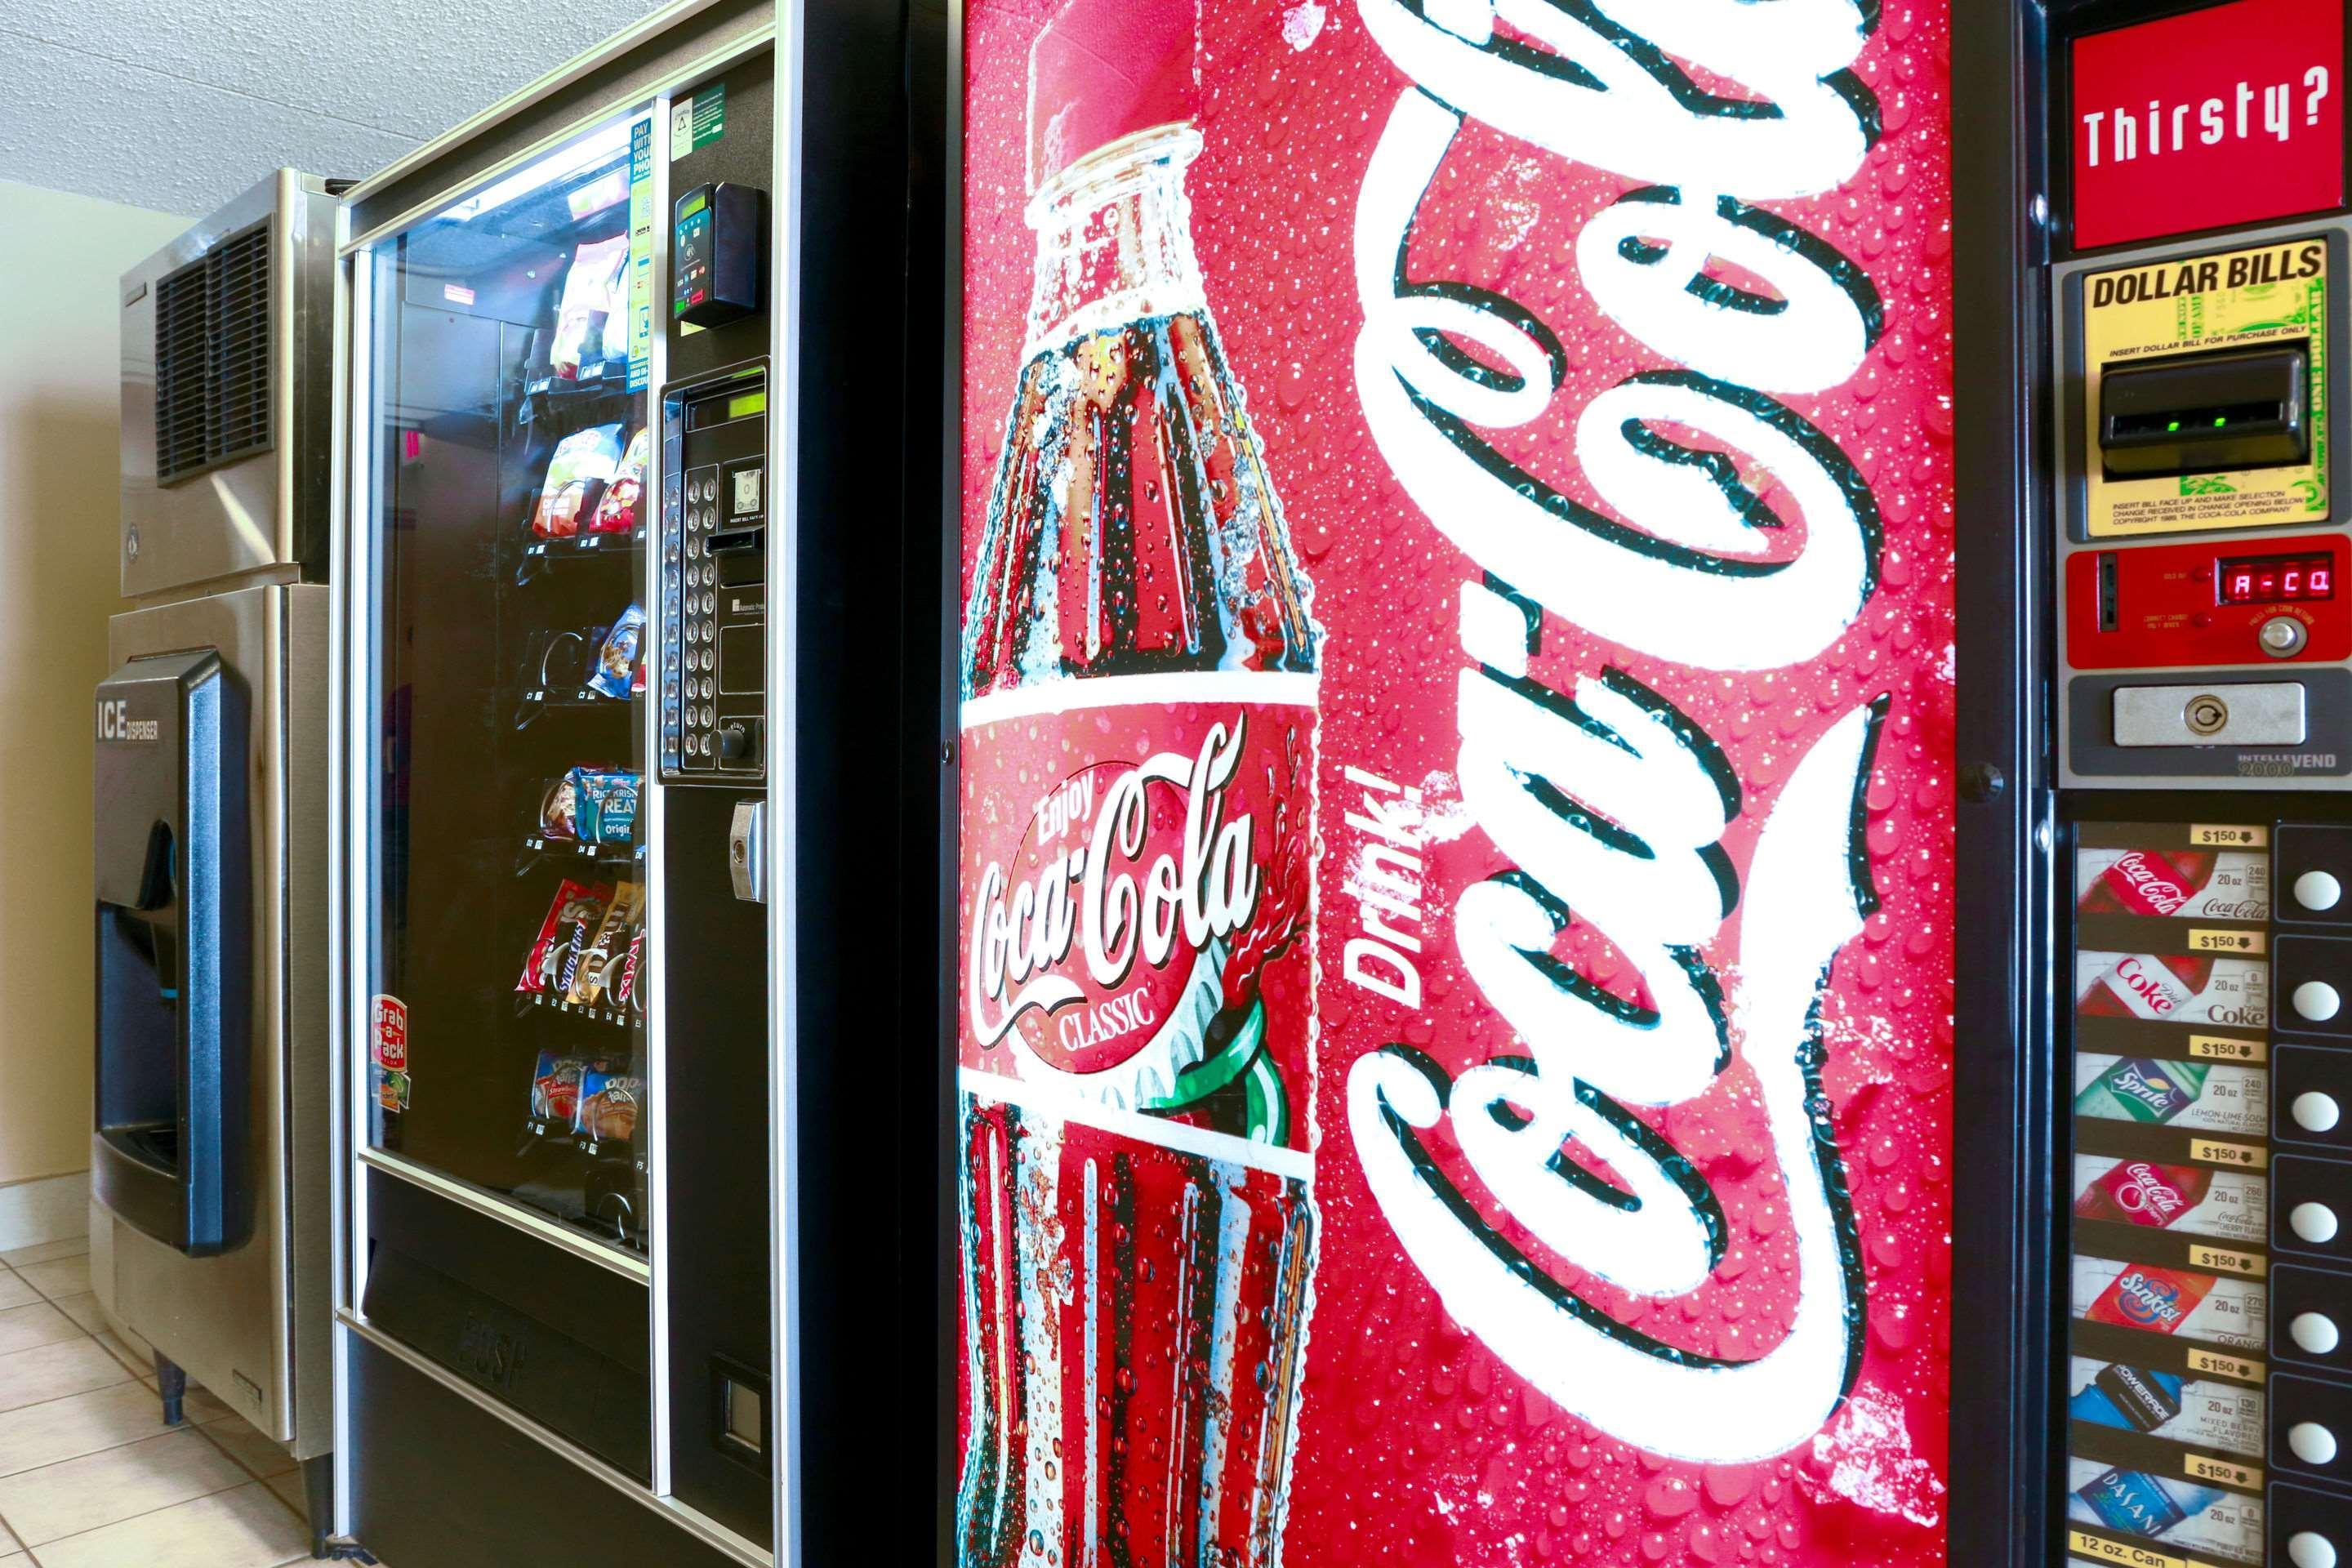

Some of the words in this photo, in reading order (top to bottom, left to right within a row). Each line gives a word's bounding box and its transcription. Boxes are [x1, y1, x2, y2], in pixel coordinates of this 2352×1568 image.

[2083, 65, 2328, 167] Thirsty?
[634, 122, 648, 140] PAY
[633, 146, 650, 163] YOU
[633, 158, 650, 176] PHO
[2092, 261, 2220, 308] DOLLAR
[2226, 245, 2322, 288] BILLS
[2109, 346, 2140, 357] INSERT
[2143, 341, 2180, 353] DOLLAR
[2182, 339, 2201, 348] BILL
[2204, 336, 2223, 345] FOR
[2226, 329, 2278, 341] PURCHASE
[2281, 325, 2306, 334] ONLY
[2113, 501, 2140, 510] INSERT
[2142, 500, 2157, 508] BILL
[2159, 498, 2180, 507] FACE
[2194, 496, 2212, 504] AND
[2213, 494, 2237, 502] MAKE
[97, 700, 127, 739] ICE
[127, 719, 158, 740] DISPENSER
[2238, 761, 2294, 777] 2000
[595, 799, 637, 813] TREAT
[1036, 770, 1094, 845] Enjoy
[970, 706, 1260, 1050] Coca-Cola
[2217, 874, 2230, 885] 20
[2248, 866, 2265, 876] 240
[1343, 765, 1422, 1010] Drink!
[2115, 853, 2187, 914] Coca-Cola
[2203, 898, 2268, 919] Coca-Cola
[2117, 957, 2172, 1015] Coke
[2215, 980, 2227, 991] 20
[375, 1003, 403, 1031] Grab
[1059, 987, 1154, 1053] CLASSIC
[2207, 1004, 2265, 1026] Coke
[385, 1027, 393, 1038] a
[375, 1028, 403, 1059] Pack
[2114, 1072, 2169, 1108] Sprite
[2213, 1085, 2226, 1096] 20
[2244, 1079, 2261, 1089] 240
[2127, 1163, 2184, 1212] Coca-Cola
[2215, 1191, 2227, 1202] 20
[2121, 1273, 2182, 1321] Sunkist
[2215, 1299, 2228, 1312] 20
[2230, 1305, 2239, 1314] oz
[2208, 1401, 2221, 1413] 20
[2222, 1407, 2234, 1415] oz
[2103, 1472, 2162, 1535] DASANI
[2211, 1509, 2224, 1521] 20
[2225, 1515, 2235, 1525] oz
[2081, 1535, 2098, 1551] 12
[2104, 1544, 2127, 1558] oz.
[2132, 1549, 2166, 1568] Can
